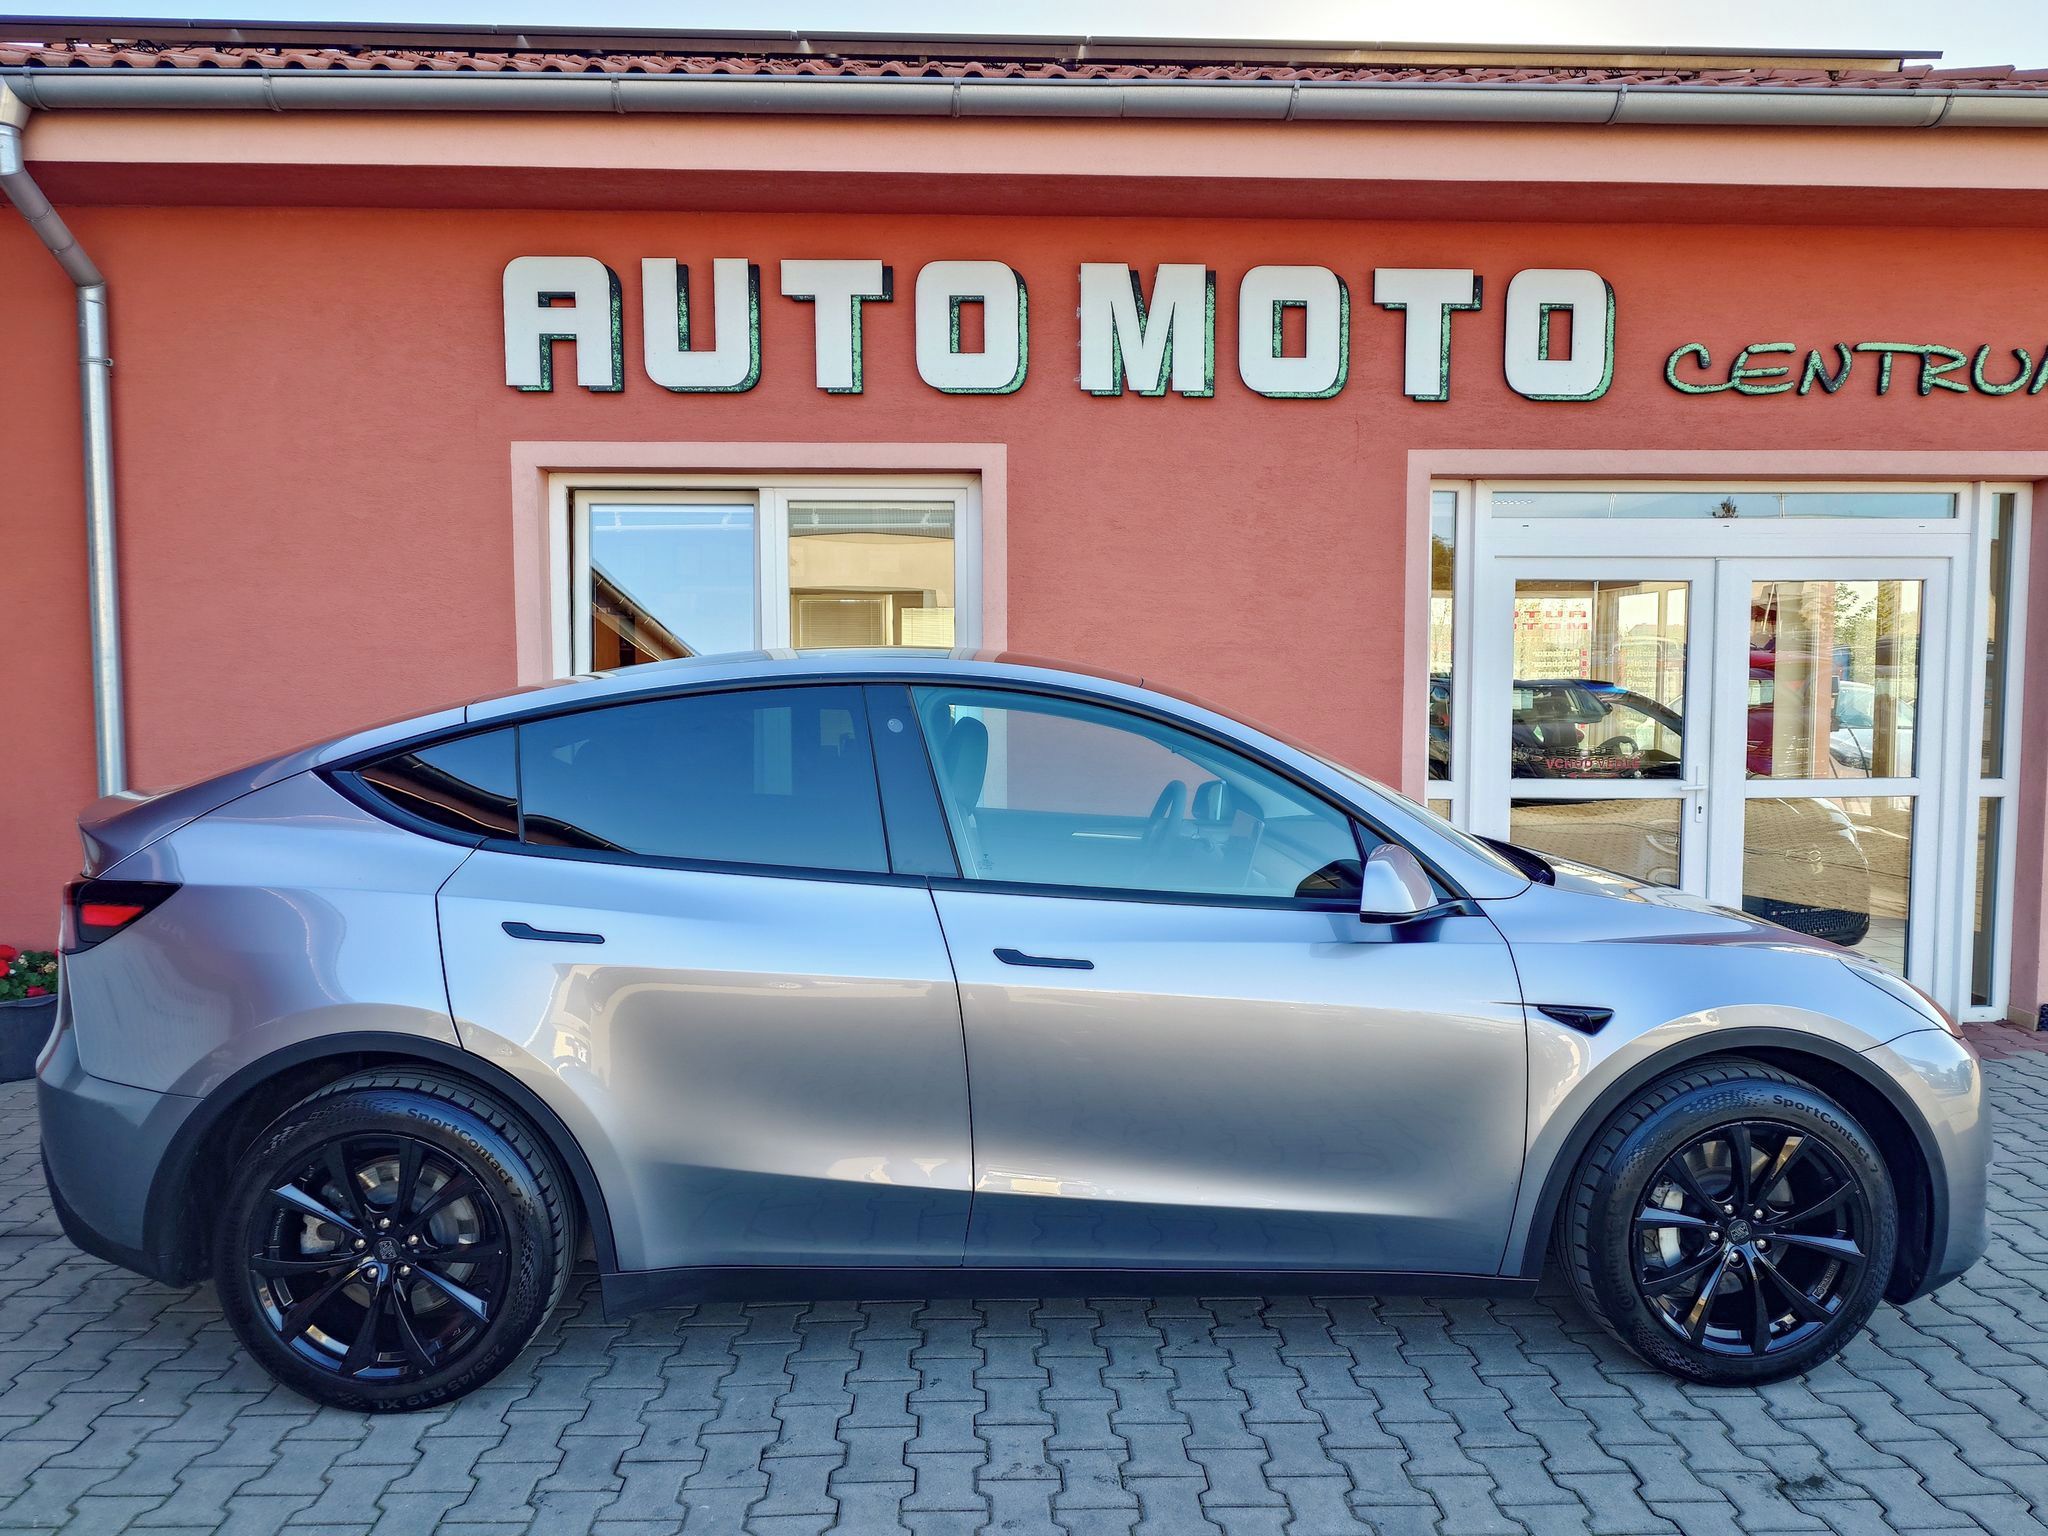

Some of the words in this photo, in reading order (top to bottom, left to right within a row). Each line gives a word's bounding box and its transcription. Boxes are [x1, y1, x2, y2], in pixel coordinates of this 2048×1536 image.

[502, 256, 1028, 395] AUTO
[1080, 263, 1616, 401] MOTO
[406, 1108, 514, 1185] SportContact
[1773, 1095, 1870, 1162] SportContact
[447, 1345, 504, 1393] 255/45
[372, 1399, 401, 1410] XL
